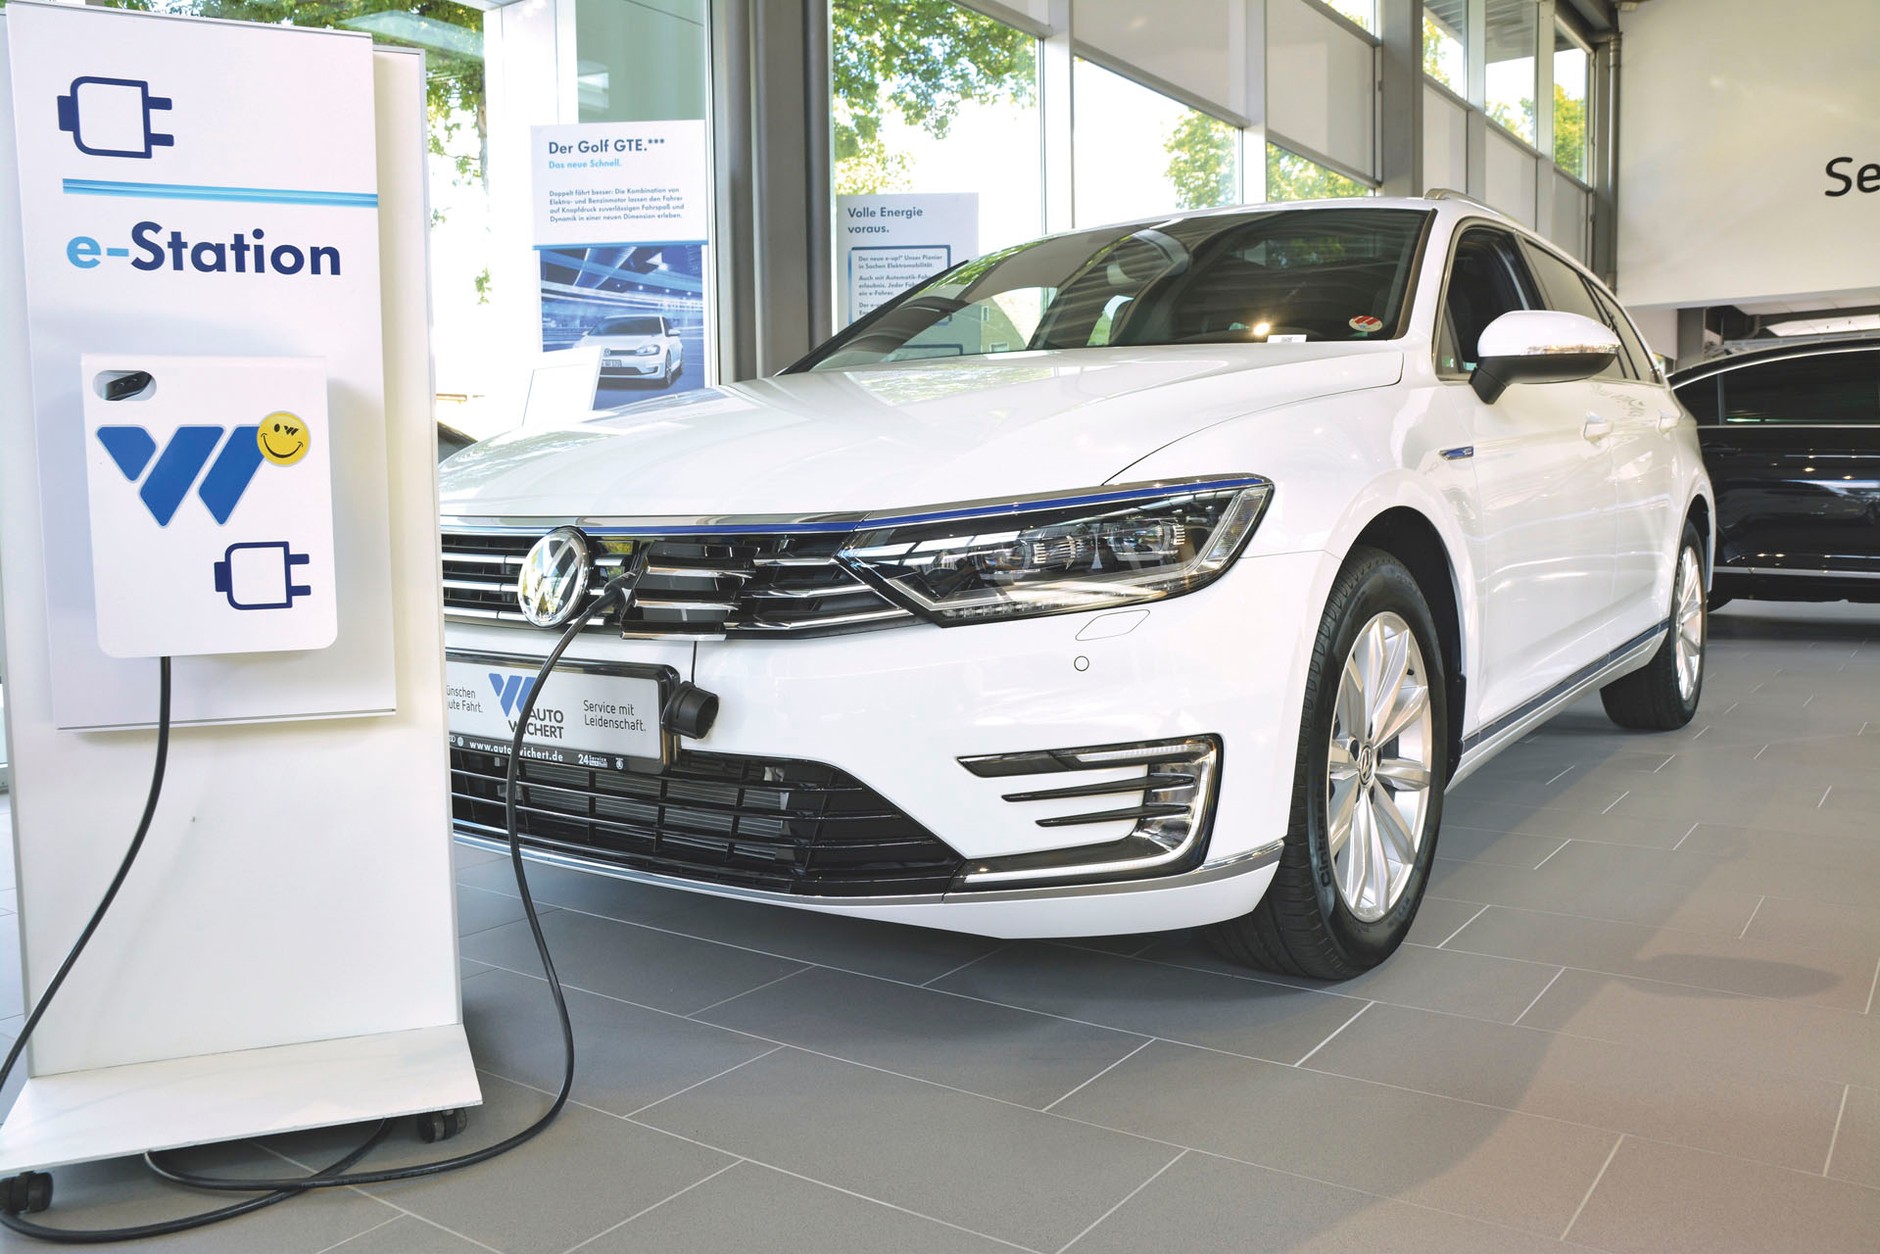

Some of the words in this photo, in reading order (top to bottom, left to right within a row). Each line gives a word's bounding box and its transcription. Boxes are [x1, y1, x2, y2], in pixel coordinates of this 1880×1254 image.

[549, 141, 573, 154] Der
[578, 139, 609, 153] Golf
[549, 161, 564, 169] Das
[590, 158, 622, 168] Schnell.
[1824, 156, 1880, 197] Se
[549, 190, 574, 198] Doppelt
[575, 189, 590, 197] fährt
[627, 187, 666, 195] Kombination
[549, 198, 573, 206] Elektro-
[562, 206, 597, 214] Knopfdruck
[599, 205, 640, 213] zuverlässigen
[642, 203, 671, 211] Fahrspaß
[550, 215, 577, 224] Dynamik
[847, 206, 876, 218] Volle
[880, 206, 923, 220] Energie
[848, 225, 890, 233] voraus.
[66, 220, 341, 276] e-Station
[447, 684, 476, 699] ünschen
[449, 699, 460, 710] ute
[461, 699, 484, 713] Fahrt.
[583, 699, 616, 714] Service
[618, 703, 635, 716] mit
[529, 708, 565, 723] AUTO
[584, 714, 647, 731] Leidenschaft.
[508, 719, 564, 739] WCHERT
[578, 753, 589, 765] 24
